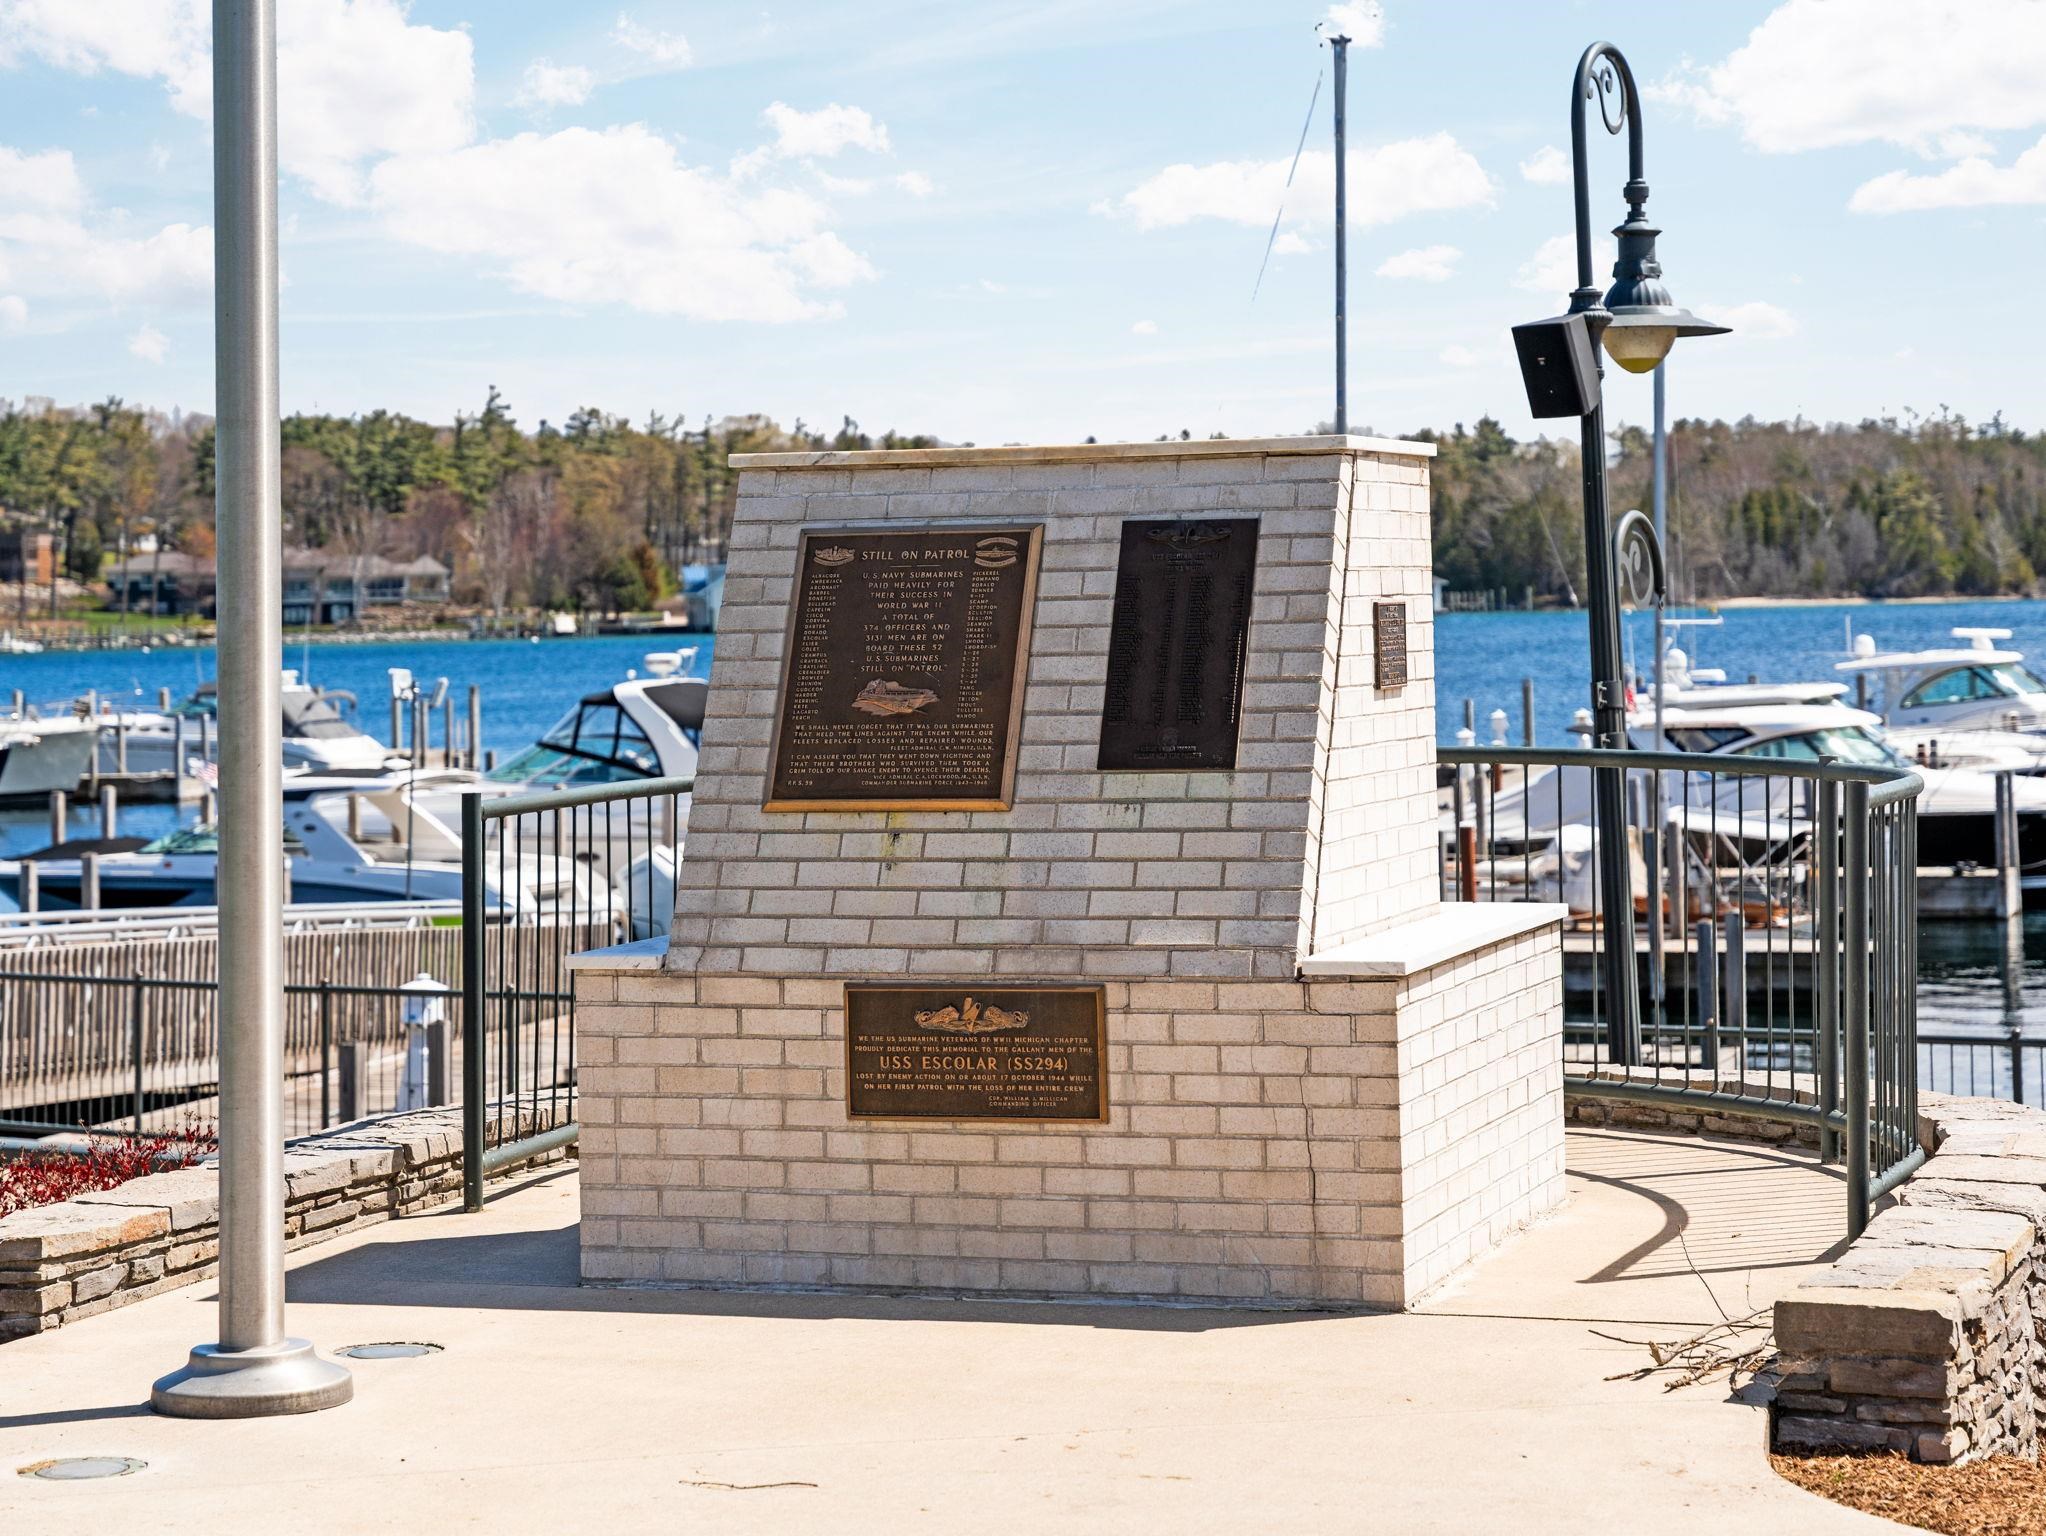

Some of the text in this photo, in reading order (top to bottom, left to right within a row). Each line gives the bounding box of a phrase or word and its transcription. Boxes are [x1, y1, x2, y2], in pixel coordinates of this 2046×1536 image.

[862, 551, 893, 560] STILL
[901, 550, 918, 559] ON
[925, 550, 969, 559] PATROL
[880, 1056, 1068, 1071] USS ESCOLAR (SS294)
